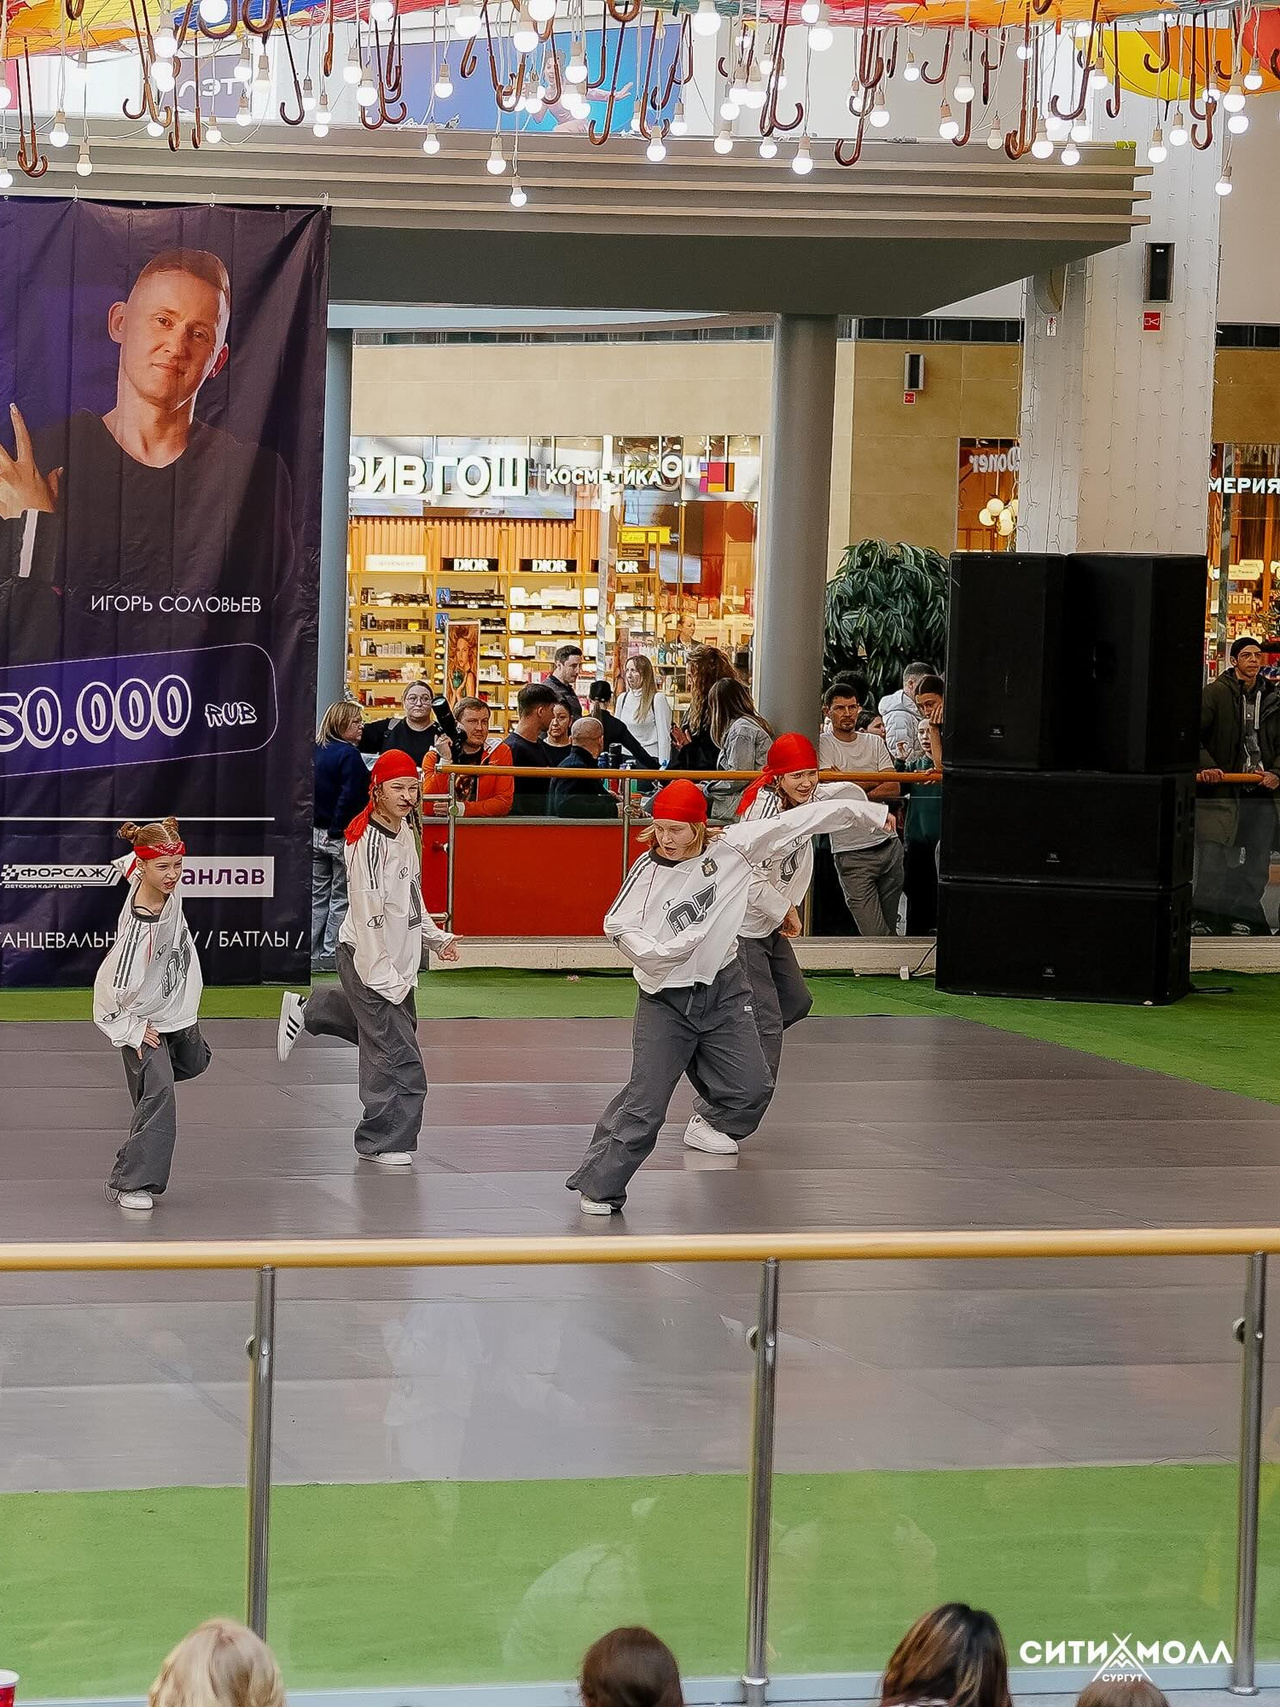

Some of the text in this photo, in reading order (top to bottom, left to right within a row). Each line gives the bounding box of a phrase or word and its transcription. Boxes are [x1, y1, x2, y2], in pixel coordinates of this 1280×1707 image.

[432, 455, 528, 497] ГОШ
[545, 466, 663, 485] КОСМЕТИКА
[453, 558, 489, 571] DIOR
[532, 559, 568, 573] DIOR
[91, 595, 262, 613] ИГОРЬ СОЛОВЬЕВ
[204, 701, 258, 728] RUB
[20, 867, 108, 878] ФОРСАЖ
[219, 931, 289, 948] БАТТЛЫ
